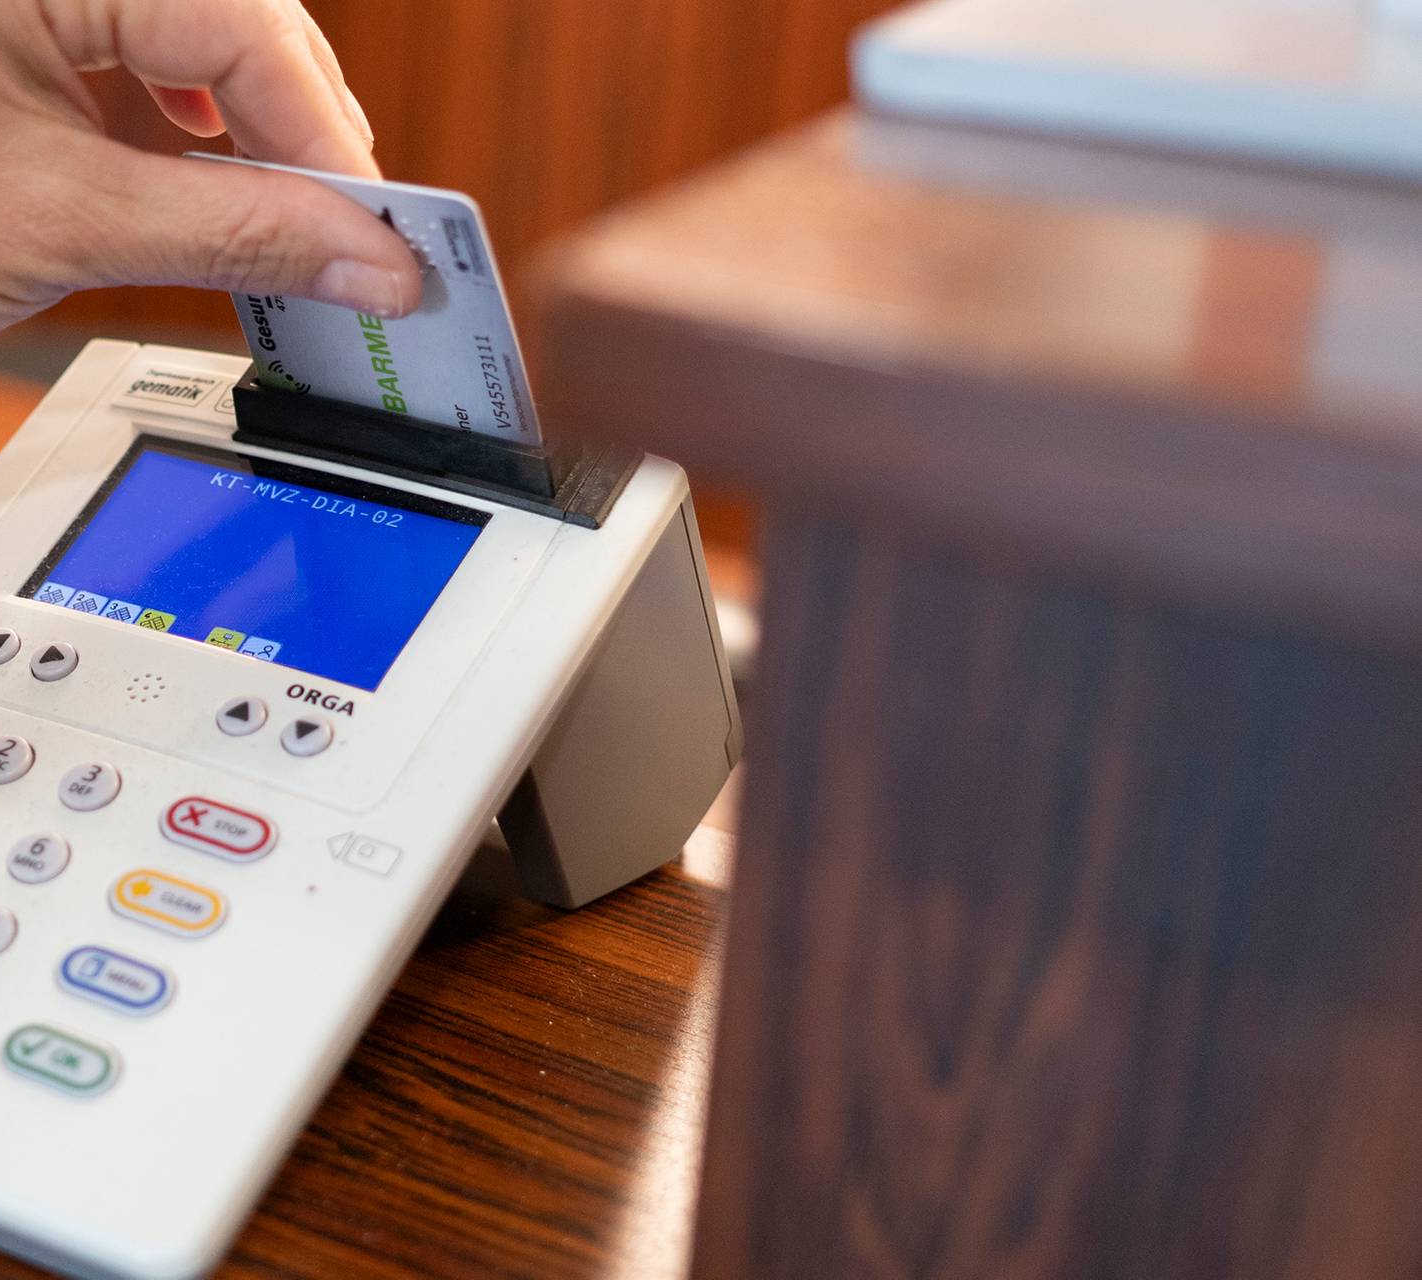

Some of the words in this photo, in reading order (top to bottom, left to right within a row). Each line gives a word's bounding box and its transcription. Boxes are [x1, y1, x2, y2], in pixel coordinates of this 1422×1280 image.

[126, 380, 203, 400] gematik
[474, 335, 512, 428] V545573111
[210, 472, 404, 528] KT-MVZ-DIA-02
[286, 684, 355, 716] ORGA
[82, 765, 102, 782] 3
[68, 782, 94, 796] DEF
[214, 819, 249, 837] STOP
[30, 838, 50, 855] 6
